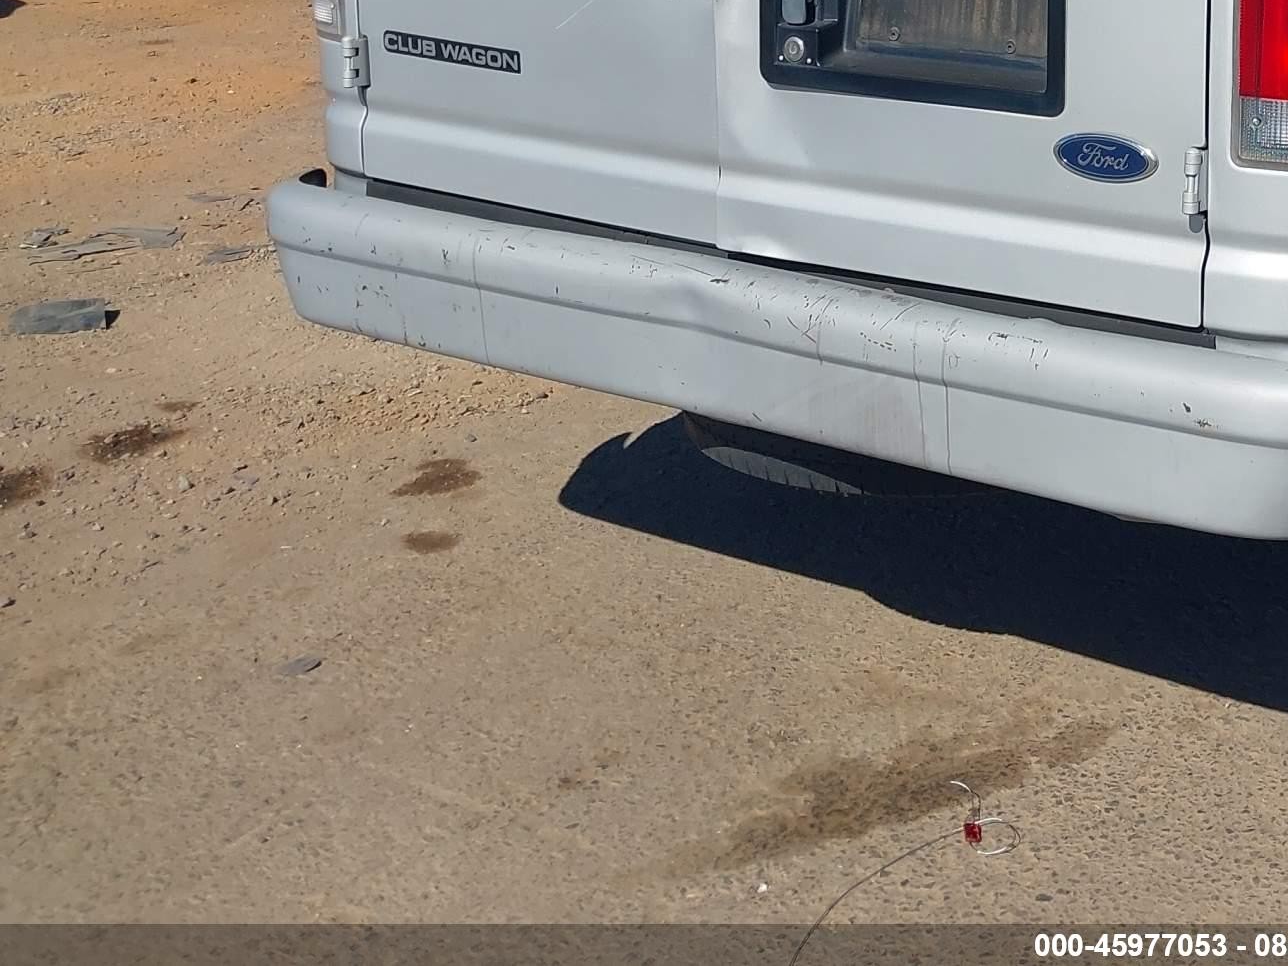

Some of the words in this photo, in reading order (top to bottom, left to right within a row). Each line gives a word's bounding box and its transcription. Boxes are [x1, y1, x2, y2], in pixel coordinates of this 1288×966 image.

[384, 33, 437, 57] CLUB
[440, 42, 519, 71] WAGON
[1077, 142, 1130, 171] Ford
